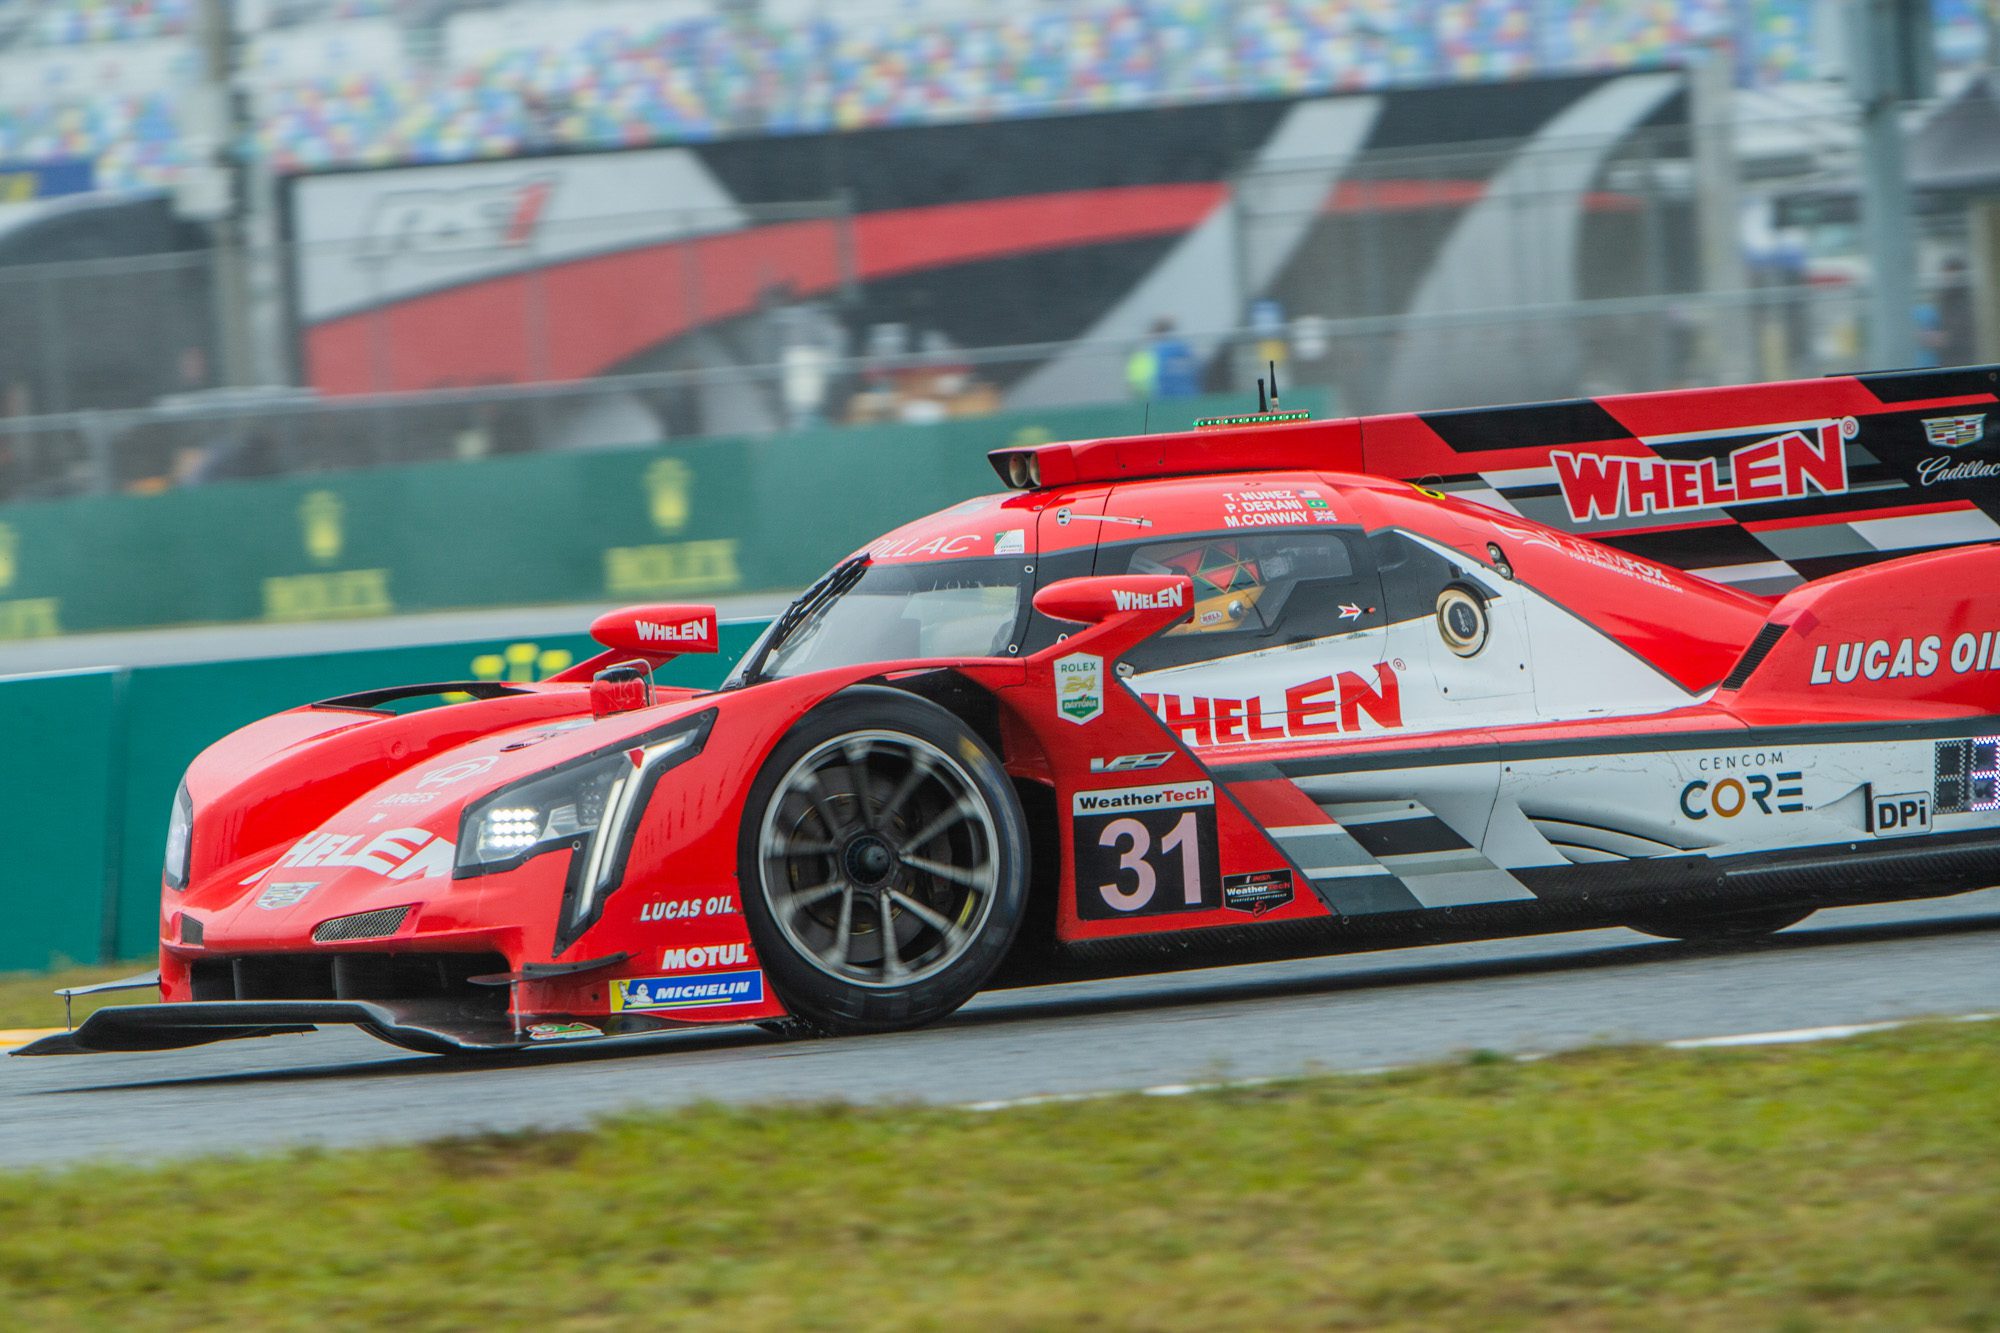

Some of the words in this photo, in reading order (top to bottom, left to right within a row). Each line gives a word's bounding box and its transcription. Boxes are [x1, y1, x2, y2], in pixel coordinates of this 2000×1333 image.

[1551, 420, 1849, 523] WHELEN
[1917, 456, 2000, 486] Cadillac
[1240, 490, 1296, 501] NUNEZ
[1242, 500, 1303, 513] DERANI
[1112, 583, 1183, 611] WHELEN
[635, 618, 708, 640] WHELEN
[1061, 662, 1096, 673] ROLEX
[1810, 635, 1942, 686] LUCAS
[1700, 752, 1784, 771] CENCOM
[1080, 787, 1208, 809] WeatherTech
[1680, 771, 1804, 820] CORE
[1878, 799, 1927, 830] DPi
[238, 827, 457, 886] HELEN
[1098, 812, 1202, 911] 31
[640, 899, 702, 922] LUCAS
[662, 943, 748, 970] MOTUL
[656, 981, 750, 1000] MICHELIN
